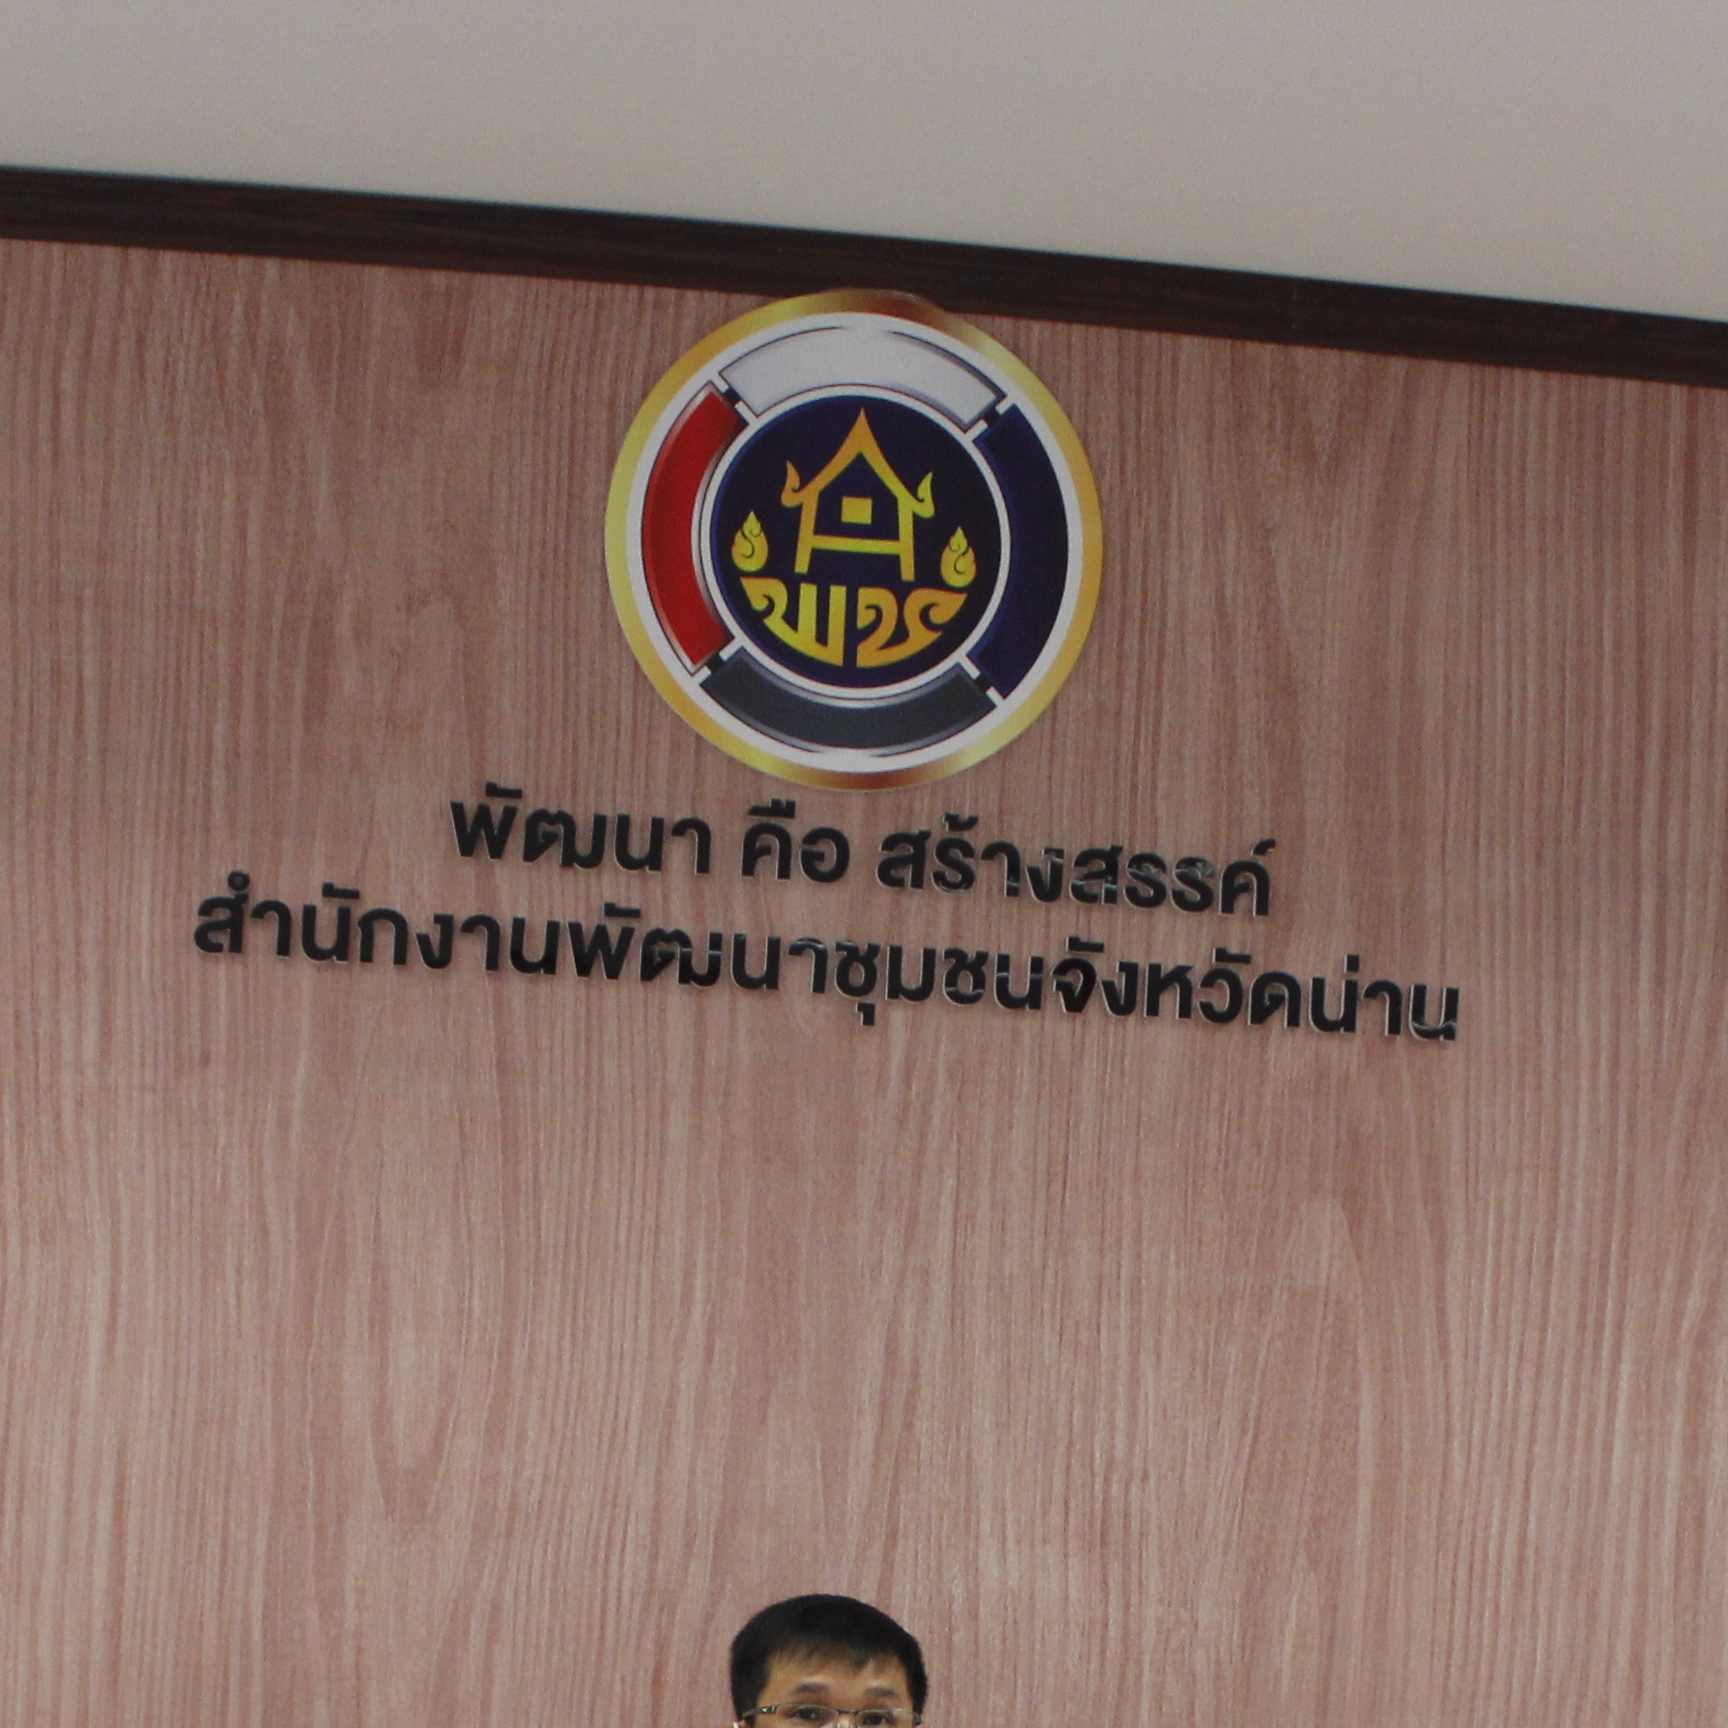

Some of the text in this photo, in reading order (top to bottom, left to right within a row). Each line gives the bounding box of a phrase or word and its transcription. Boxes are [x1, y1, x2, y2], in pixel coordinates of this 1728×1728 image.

[450, 782, 1277, 917] พัฒนา คือ สร้างสรรค์
[193, 870, 1460, 1043] สำนักงานพัฒนาชุมชนจังหวัดน่าน
